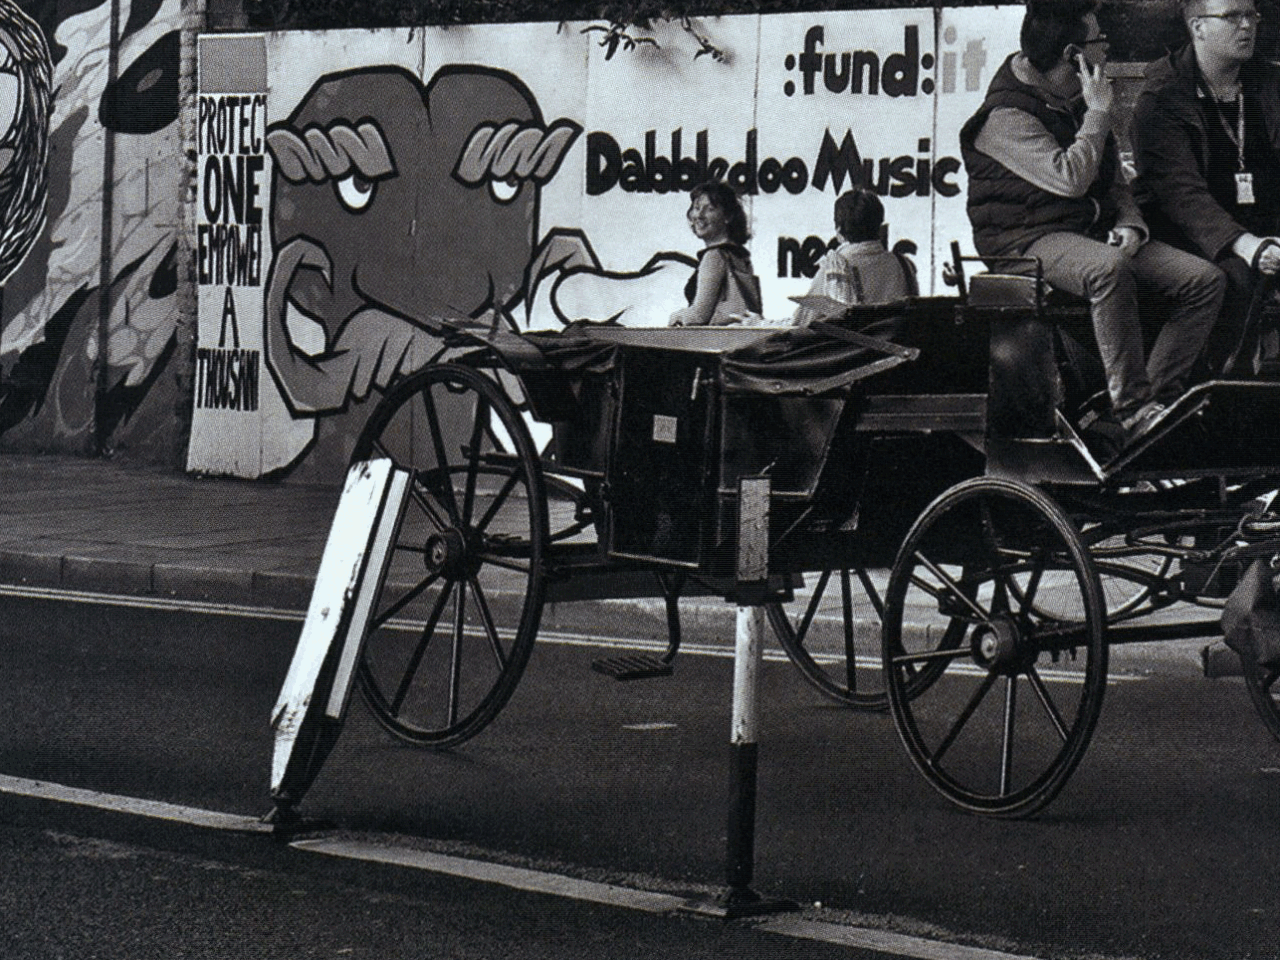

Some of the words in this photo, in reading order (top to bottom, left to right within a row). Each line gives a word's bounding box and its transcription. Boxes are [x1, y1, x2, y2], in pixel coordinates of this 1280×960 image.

[204, 155, 264, 224] ONE
[586, 127, 808, 196] Dabbledoo
[811, 127, 962, 198] Music
[219, 287, 239, 347] A
